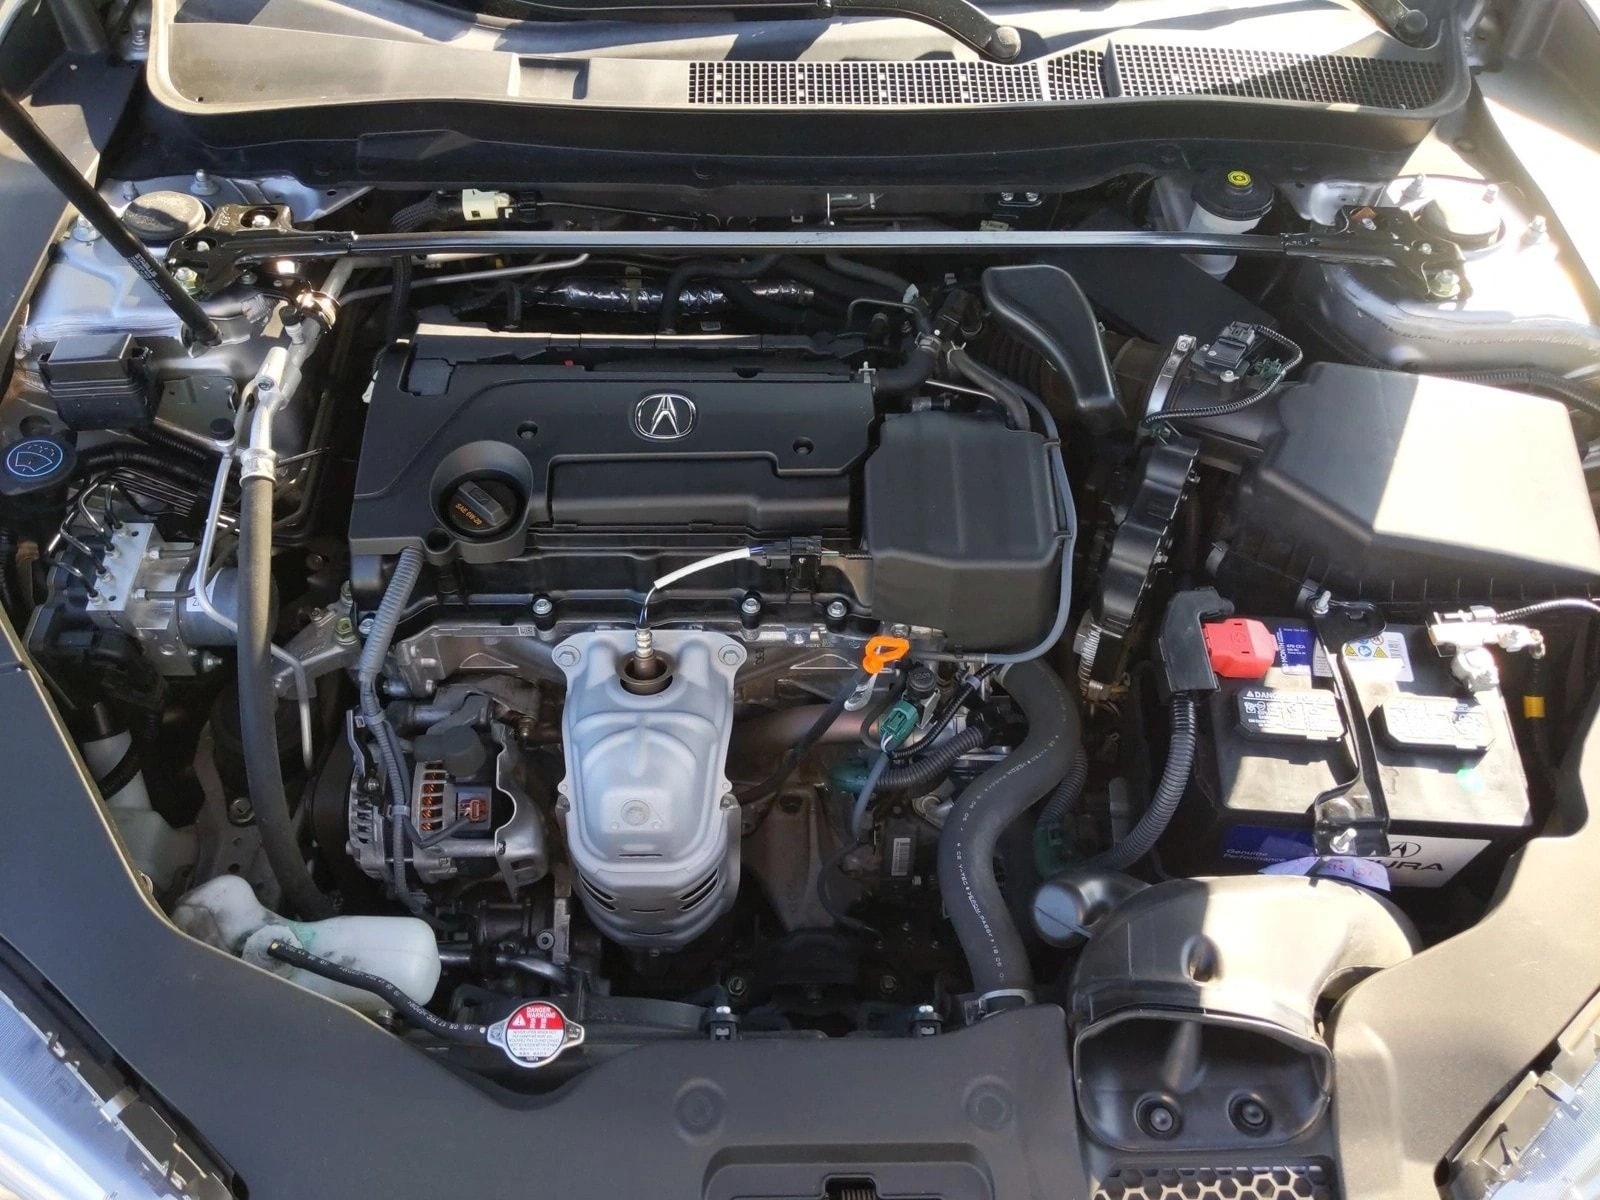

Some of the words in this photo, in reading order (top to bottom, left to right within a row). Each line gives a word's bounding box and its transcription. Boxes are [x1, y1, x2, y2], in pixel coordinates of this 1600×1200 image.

[455, 503, 468, 514] SAE
[465, 511, 483, 525] 0W-20
[1278, 642, 1288, 663] MONTH
[1223, 853, 1287, 862] Performance
[1226, 848, 1268, 856] Genuine
